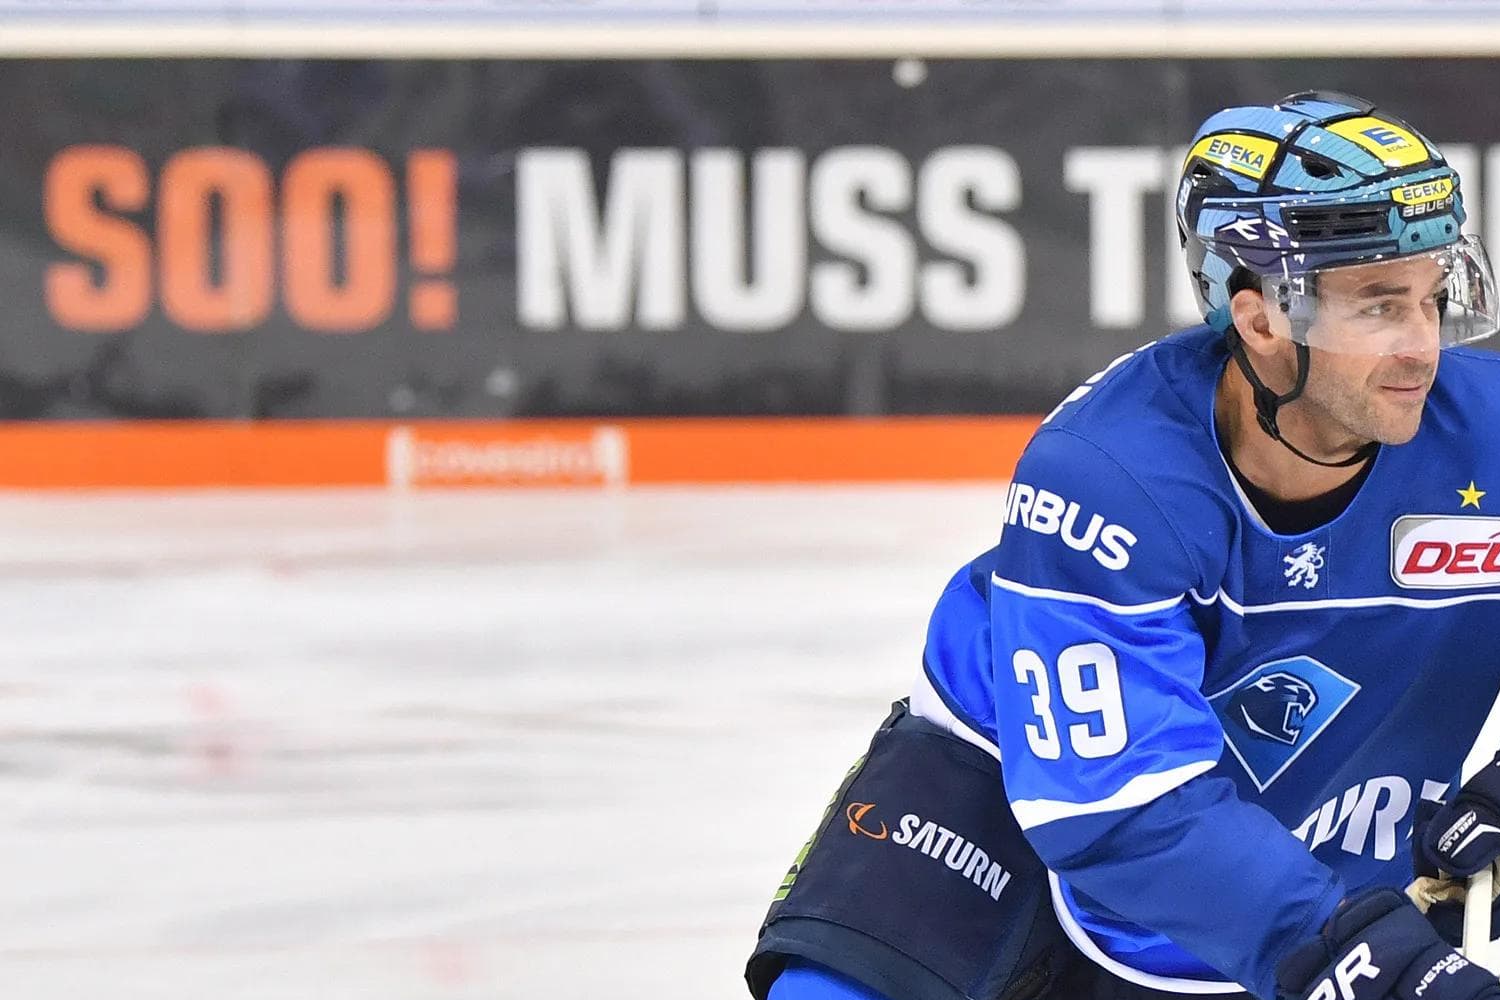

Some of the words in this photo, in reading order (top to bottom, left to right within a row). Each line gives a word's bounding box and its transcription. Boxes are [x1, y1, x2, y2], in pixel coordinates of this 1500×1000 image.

[1209, 138, 1264, 168] EDEKA
[1402, 182, 1448, 201] EDEKA
[44, 144, 458, 332] SOO!
[515, 146, 1026, 332] MUSS
[1002, 482, 1138, 571] IRBUS
[1012, 642, 1128, 760] 39
[891, 813, 1012, 902] SATURN
[1415, 953, 1461, 997] NEXUS
